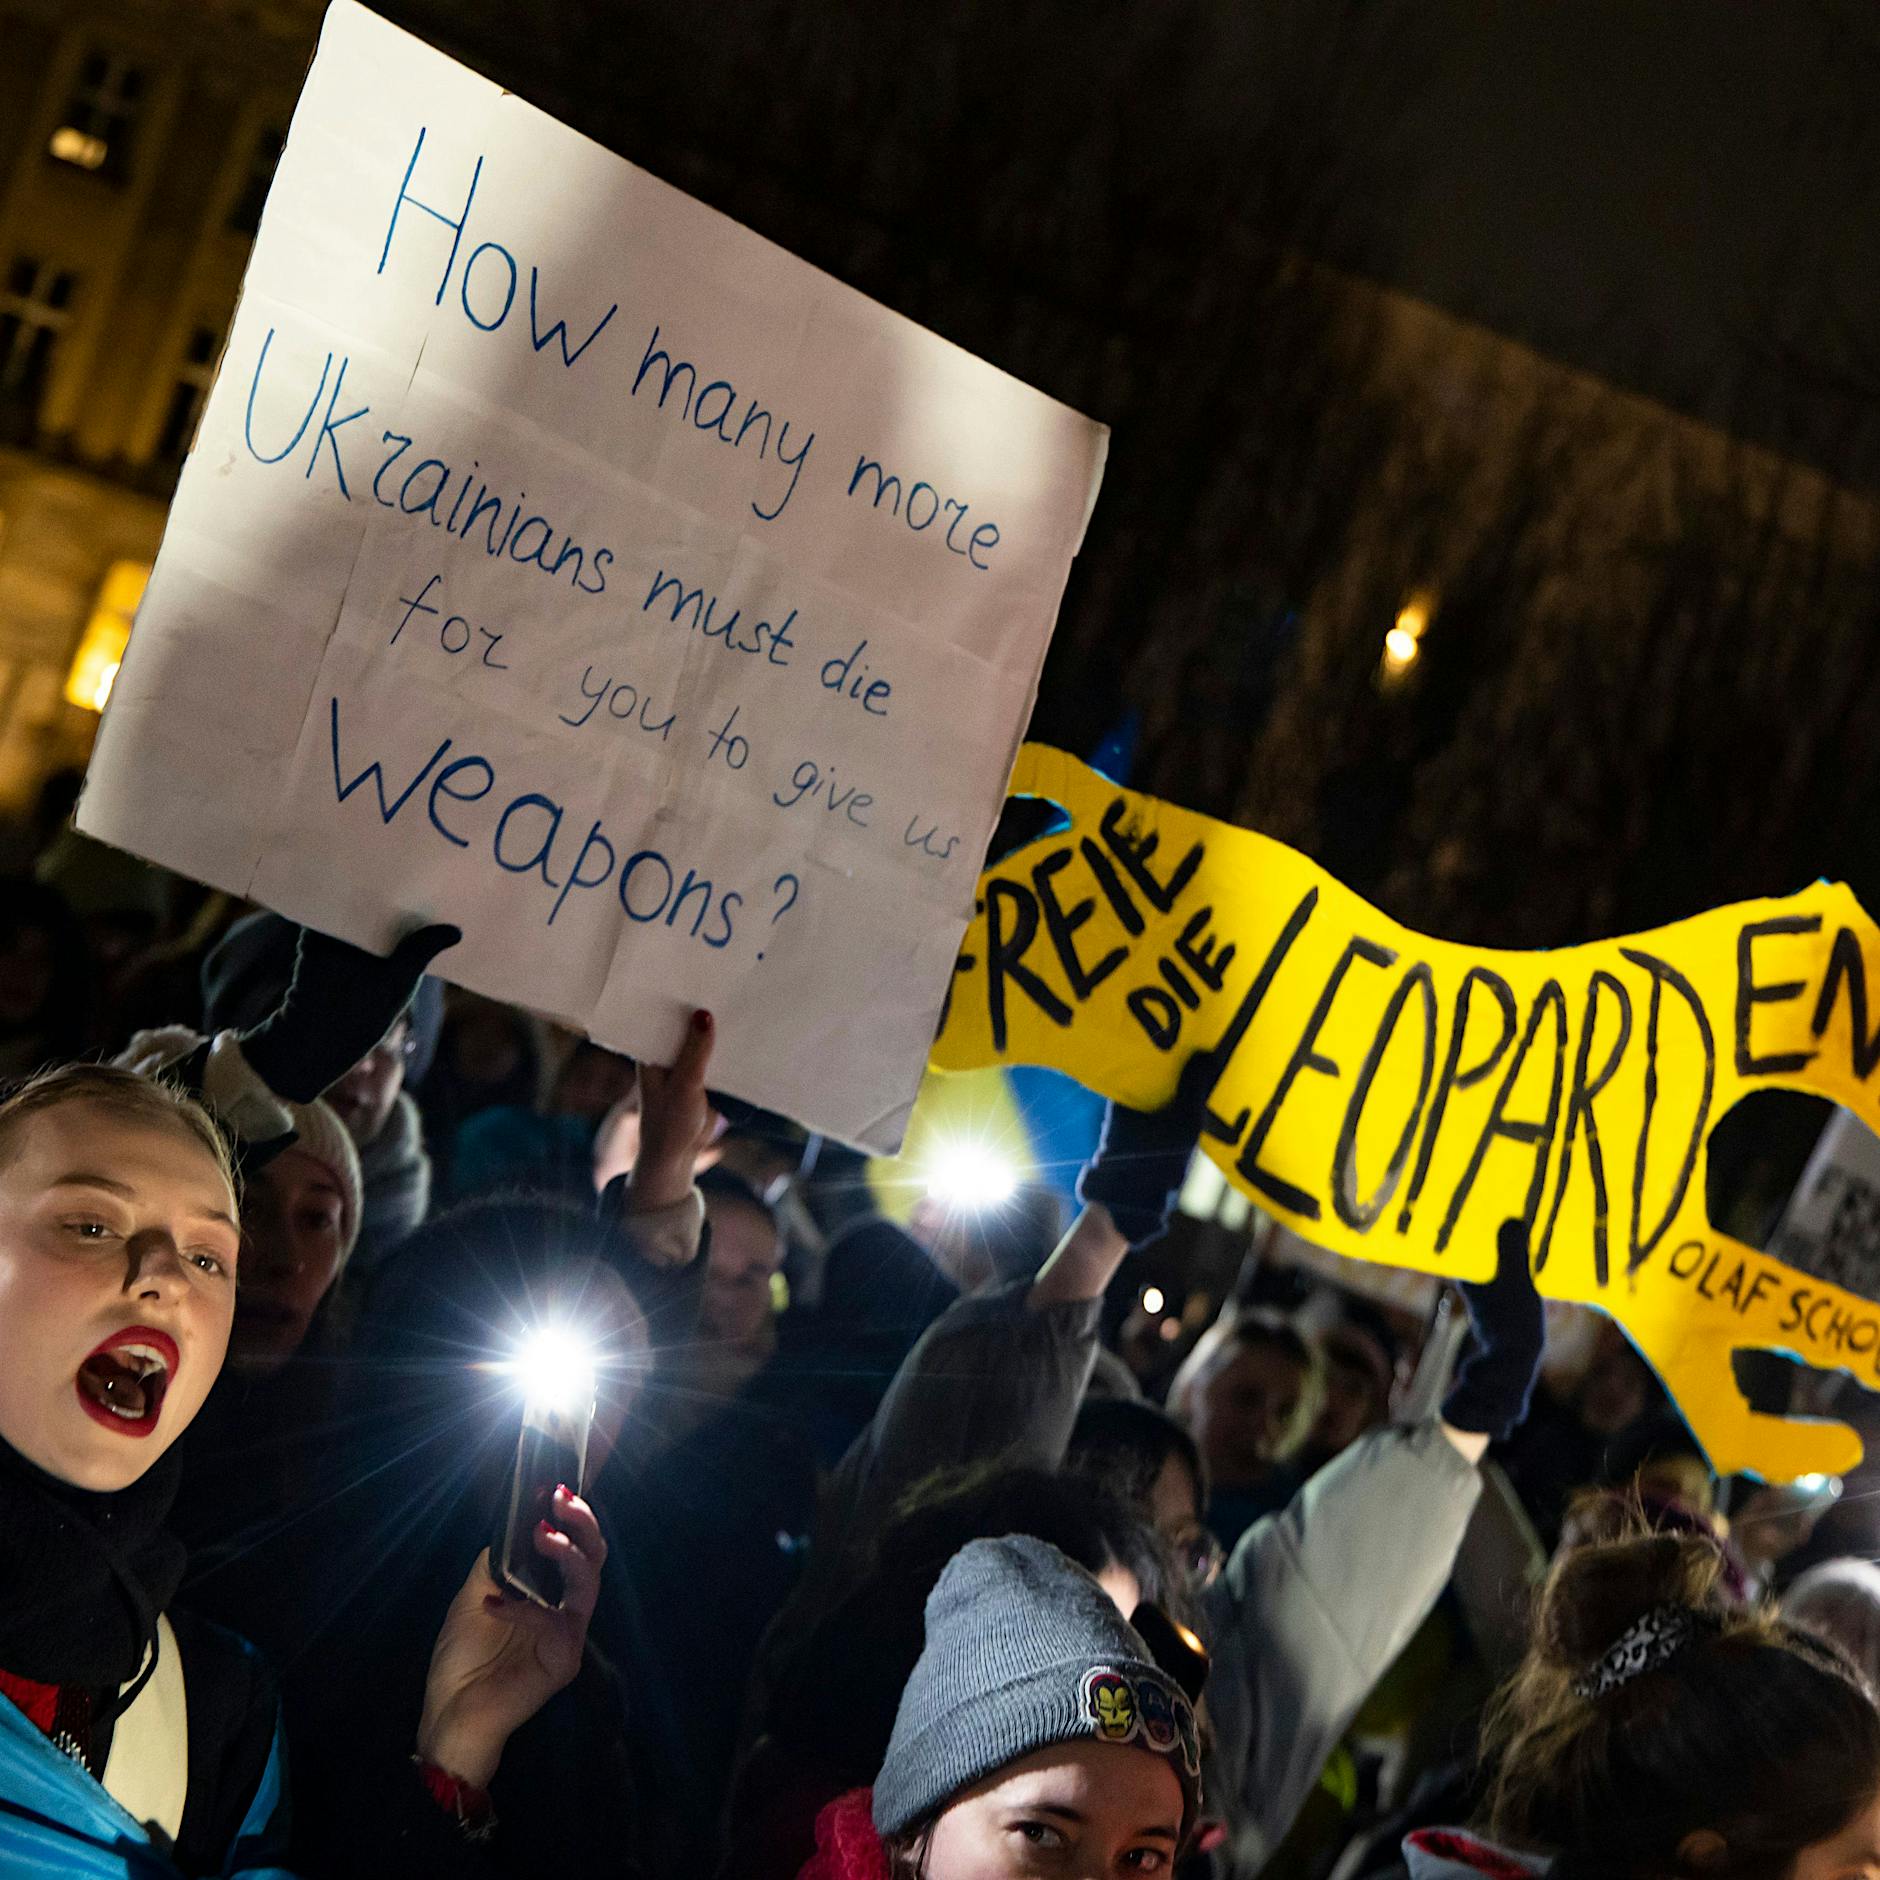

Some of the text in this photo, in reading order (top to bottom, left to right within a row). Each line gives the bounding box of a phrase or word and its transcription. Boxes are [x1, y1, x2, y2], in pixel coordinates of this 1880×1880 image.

[377, 126, 1001, 570] How many more
[244, 328, 892, 716] Ukrainians must die
[391, 575, 961, 860] for you to give us
[1127, 904, 1237, 1052] DIE
[1669, 1241, 1880, 1378] OLAF SCHO
